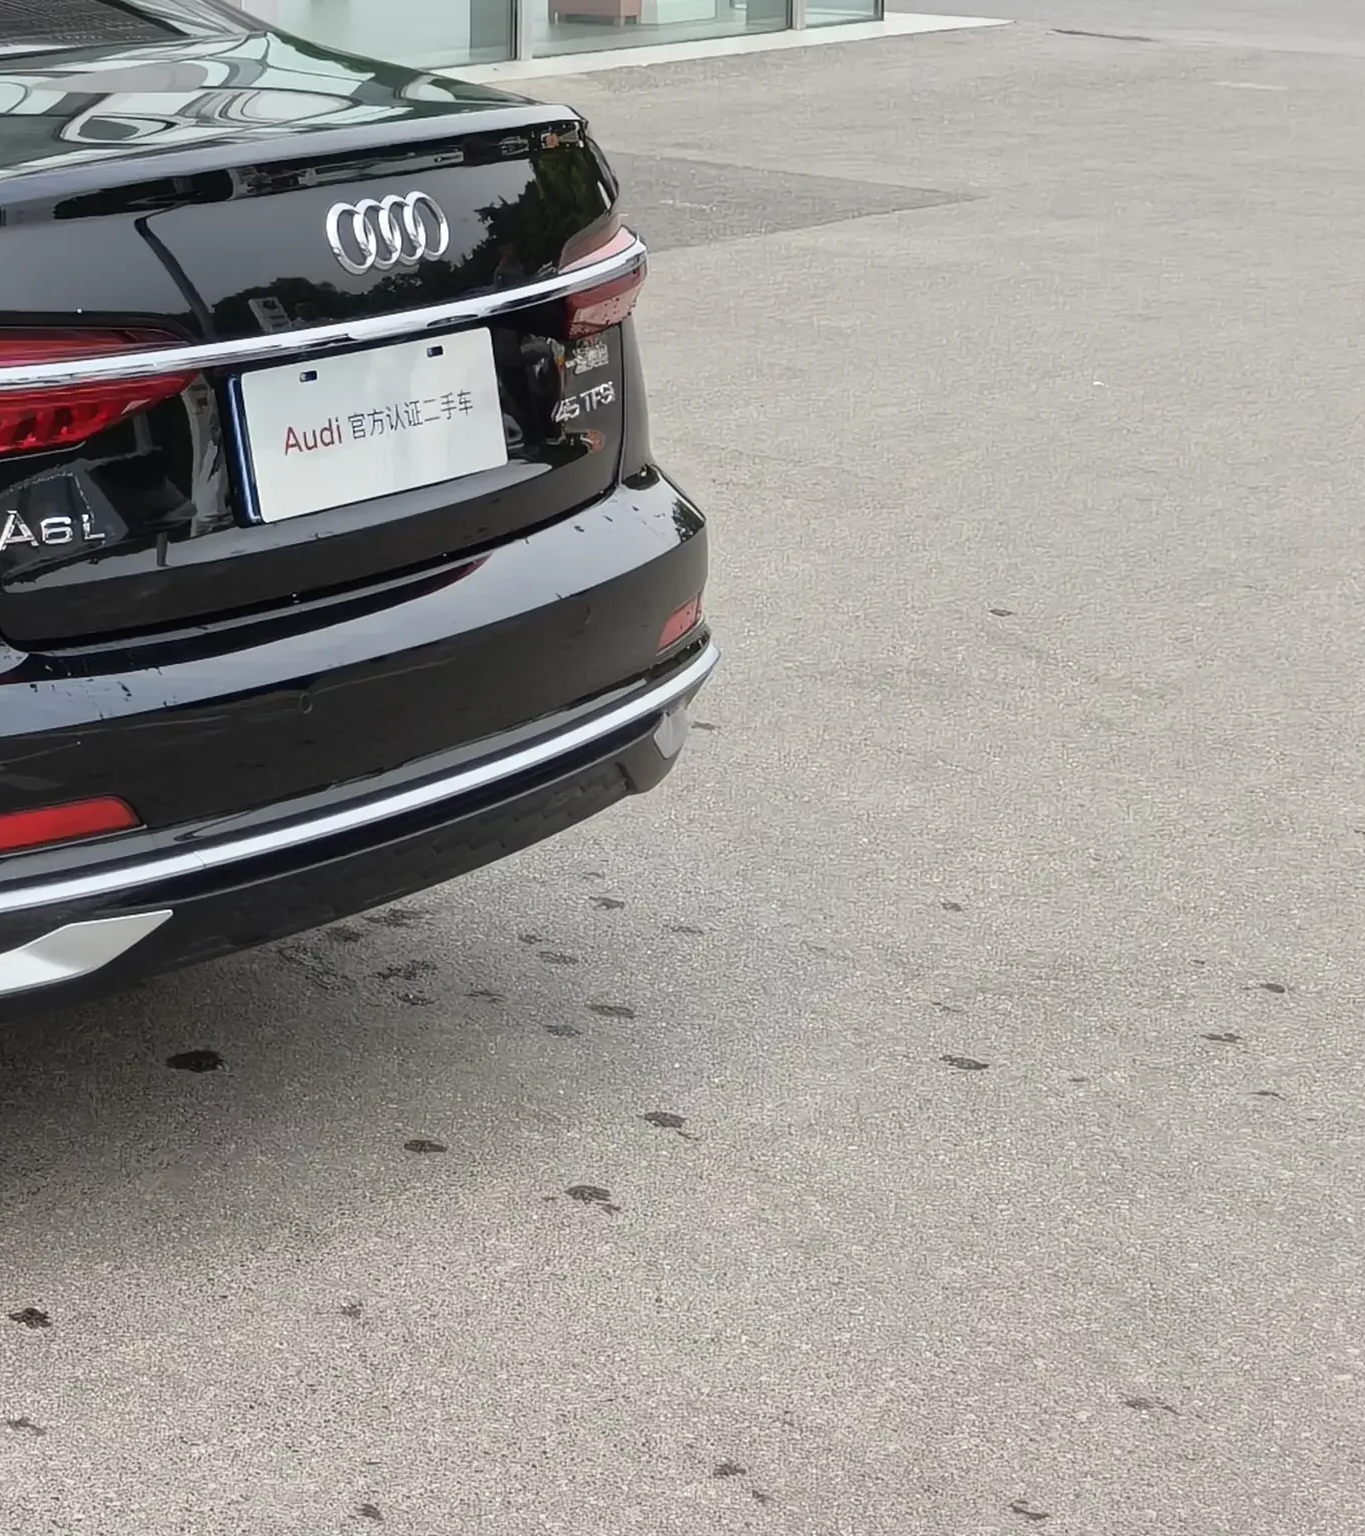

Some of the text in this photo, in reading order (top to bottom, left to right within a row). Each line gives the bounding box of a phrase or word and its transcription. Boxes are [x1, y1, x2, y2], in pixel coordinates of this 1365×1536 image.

[284, 389, 474, 456] Audi 官方认证二手车
[554, 396, 580, 423] 45
